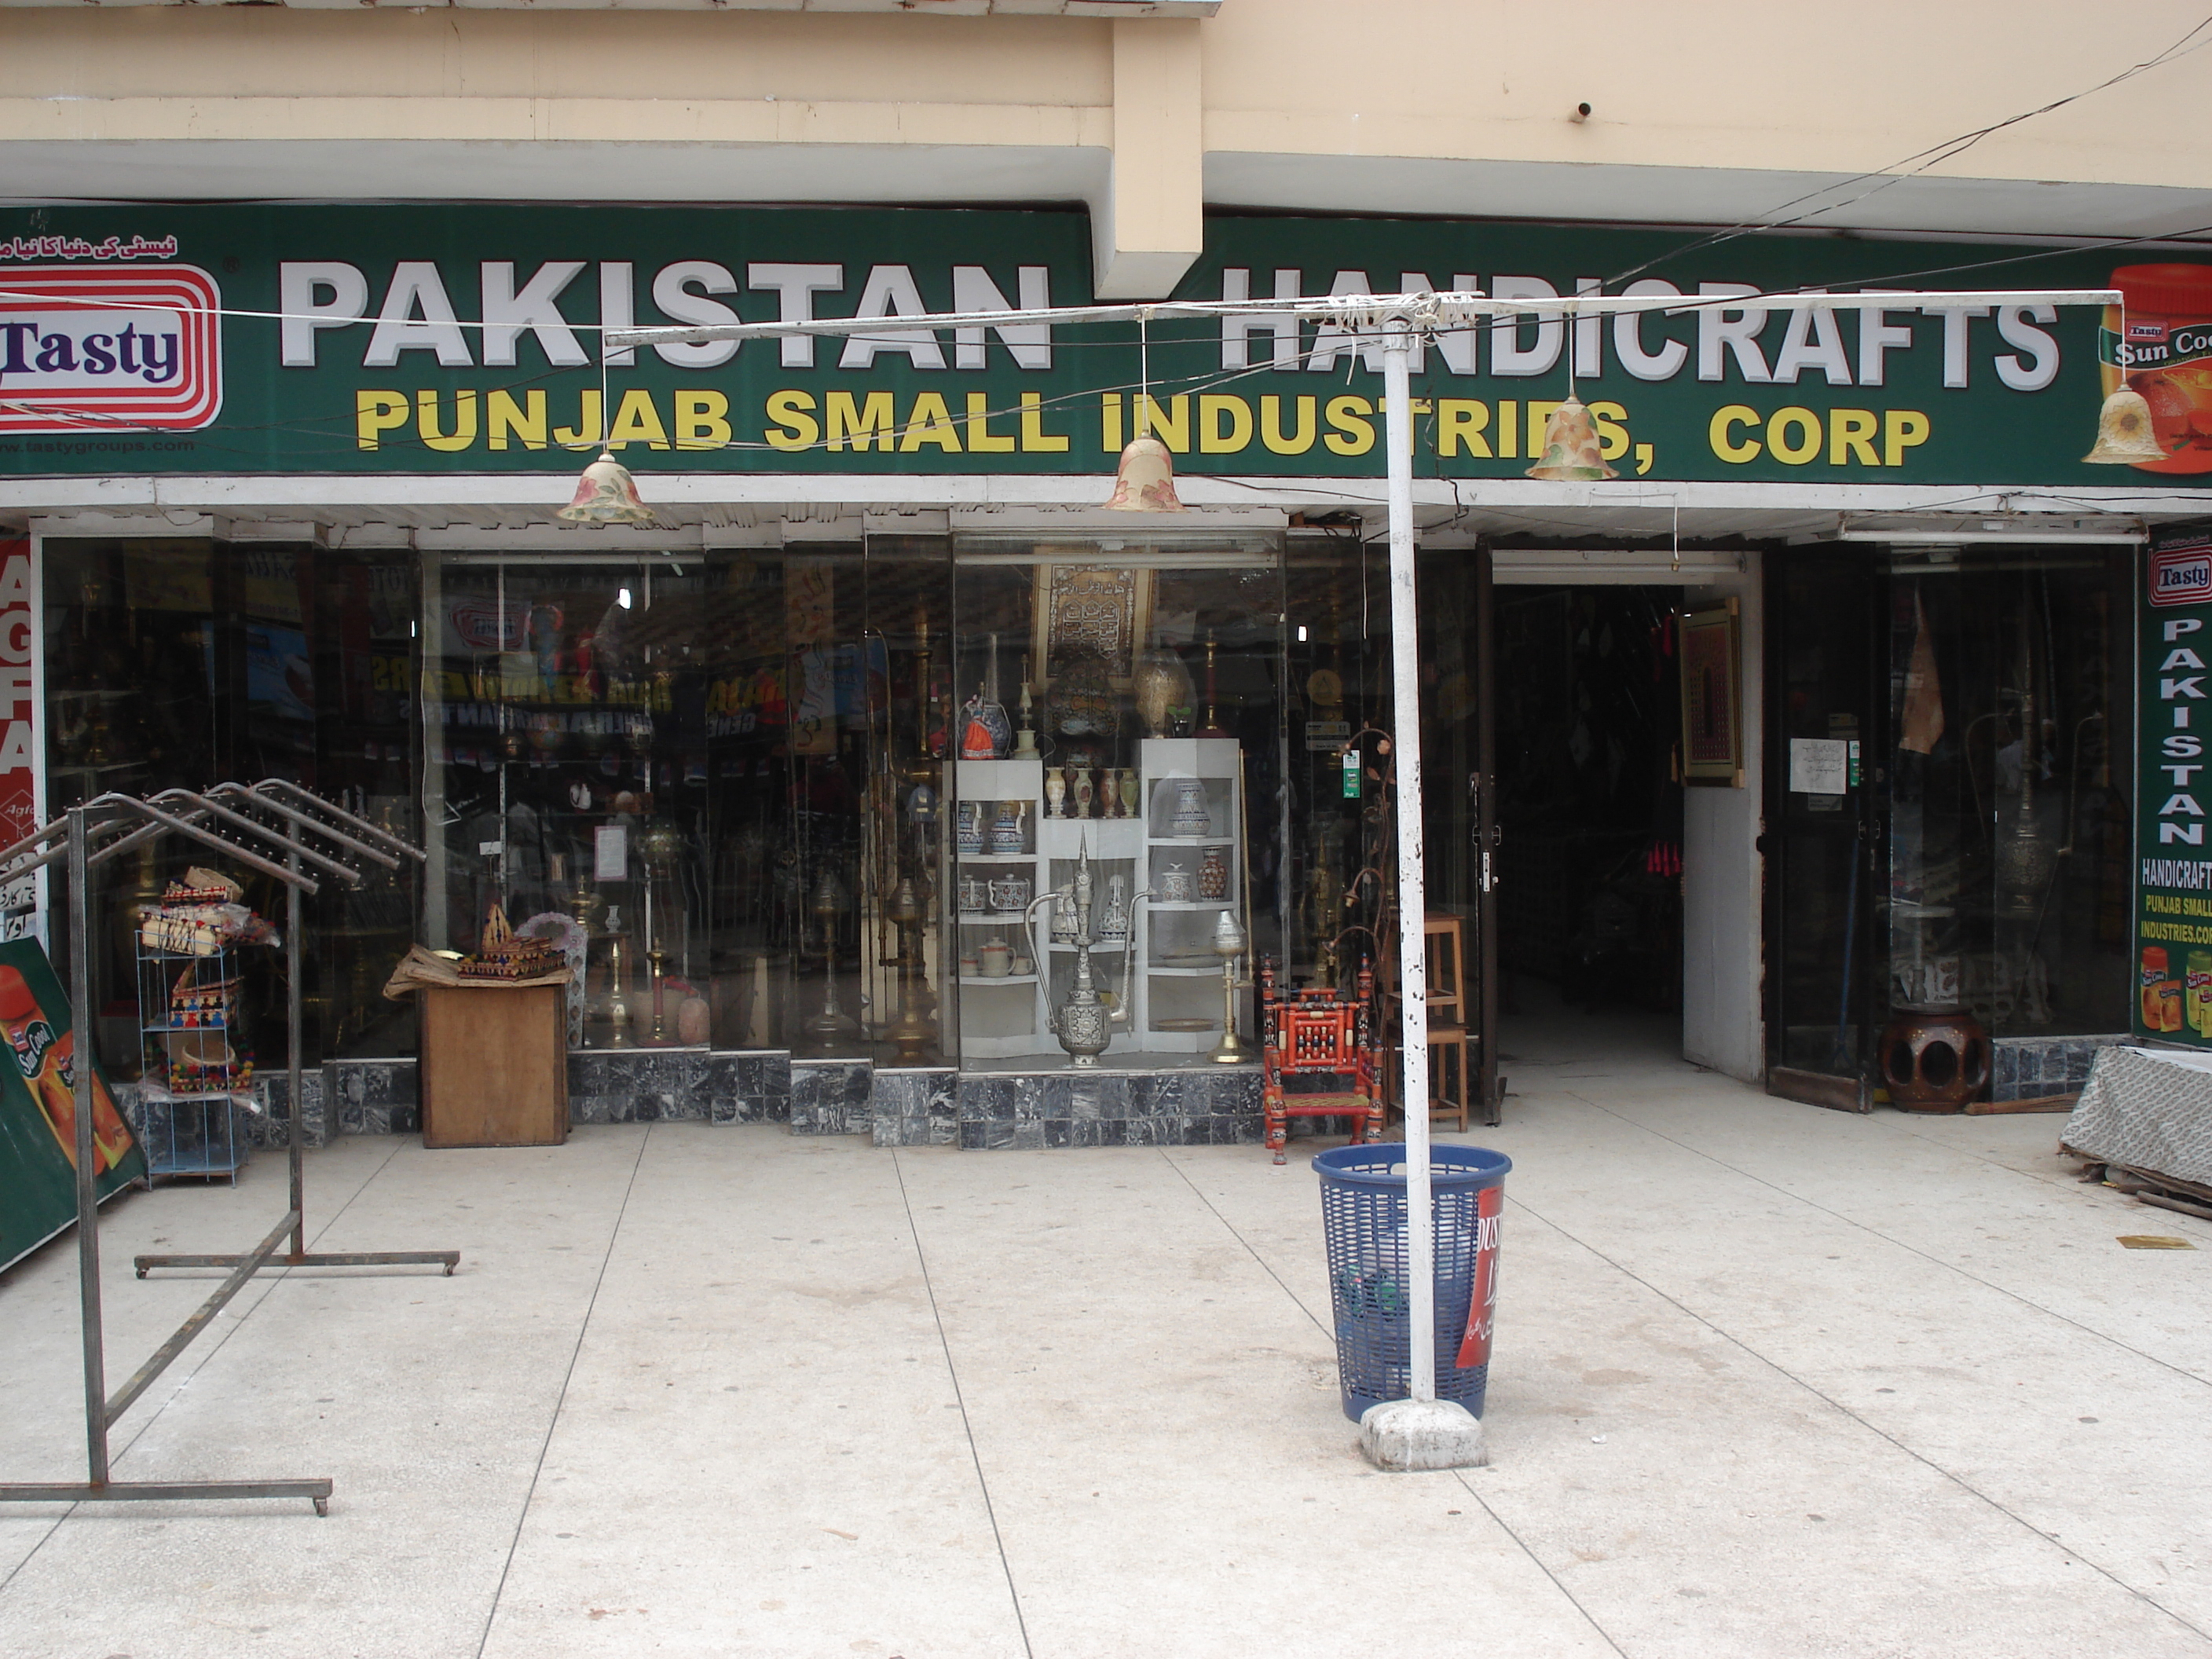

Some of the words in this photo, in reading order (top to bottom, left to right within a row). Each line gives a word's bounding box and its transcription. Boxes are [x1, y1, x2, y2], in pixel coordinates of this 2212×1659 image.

[0, 322, 178, 383] Tasty
[280, 261, 1052, 369] PAKISTAN
[1221, 268, 2060, 391] HANDICRAFTS
[2115, 342, 2169, 365] Sun
[356, 390, 732, 452] PUNJAB
[764, 390, 1069, 453] SMALL
[1708, 404, 1931, 467] CORP
[2160, 566, 2208, 587] Tasty
[0, 555, 33, 775] AGFA
[2158, 618, 2208, 846] PAKISTAN
[2145, 894, 2181, 915] PUNJAB
[2183, 897, 2212, 918] SMALL
